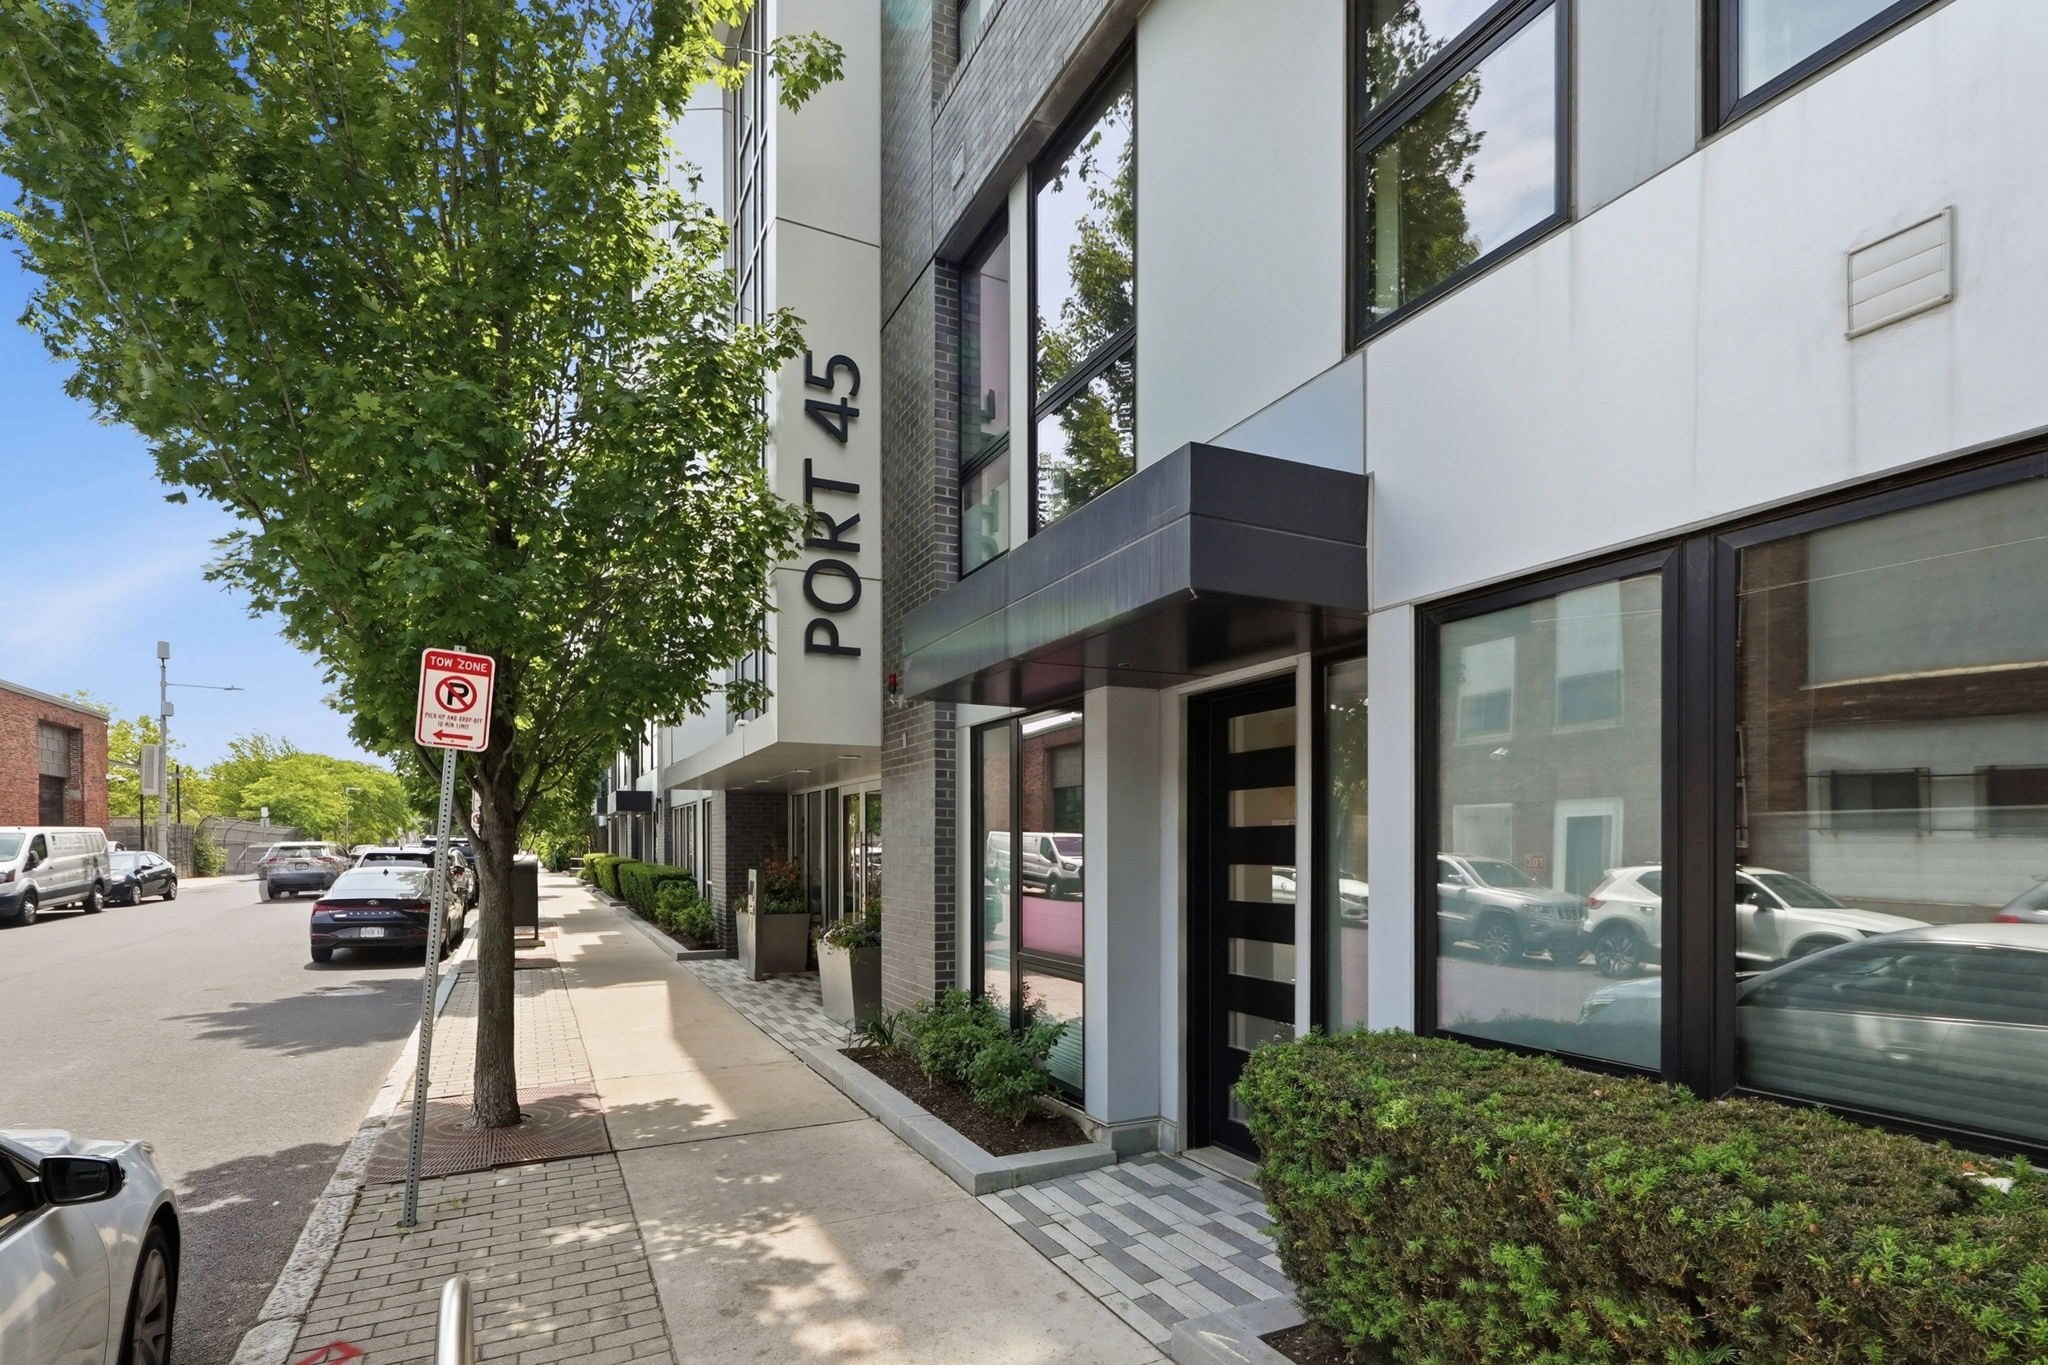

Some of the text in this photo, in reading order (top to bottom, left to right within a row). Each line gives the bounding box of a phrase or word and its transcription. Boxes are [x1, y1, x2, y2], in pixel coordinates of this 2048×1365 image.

[803, 350, 862, 657] PORT 45
[430, 656, 488, 673] TOW ZONE
